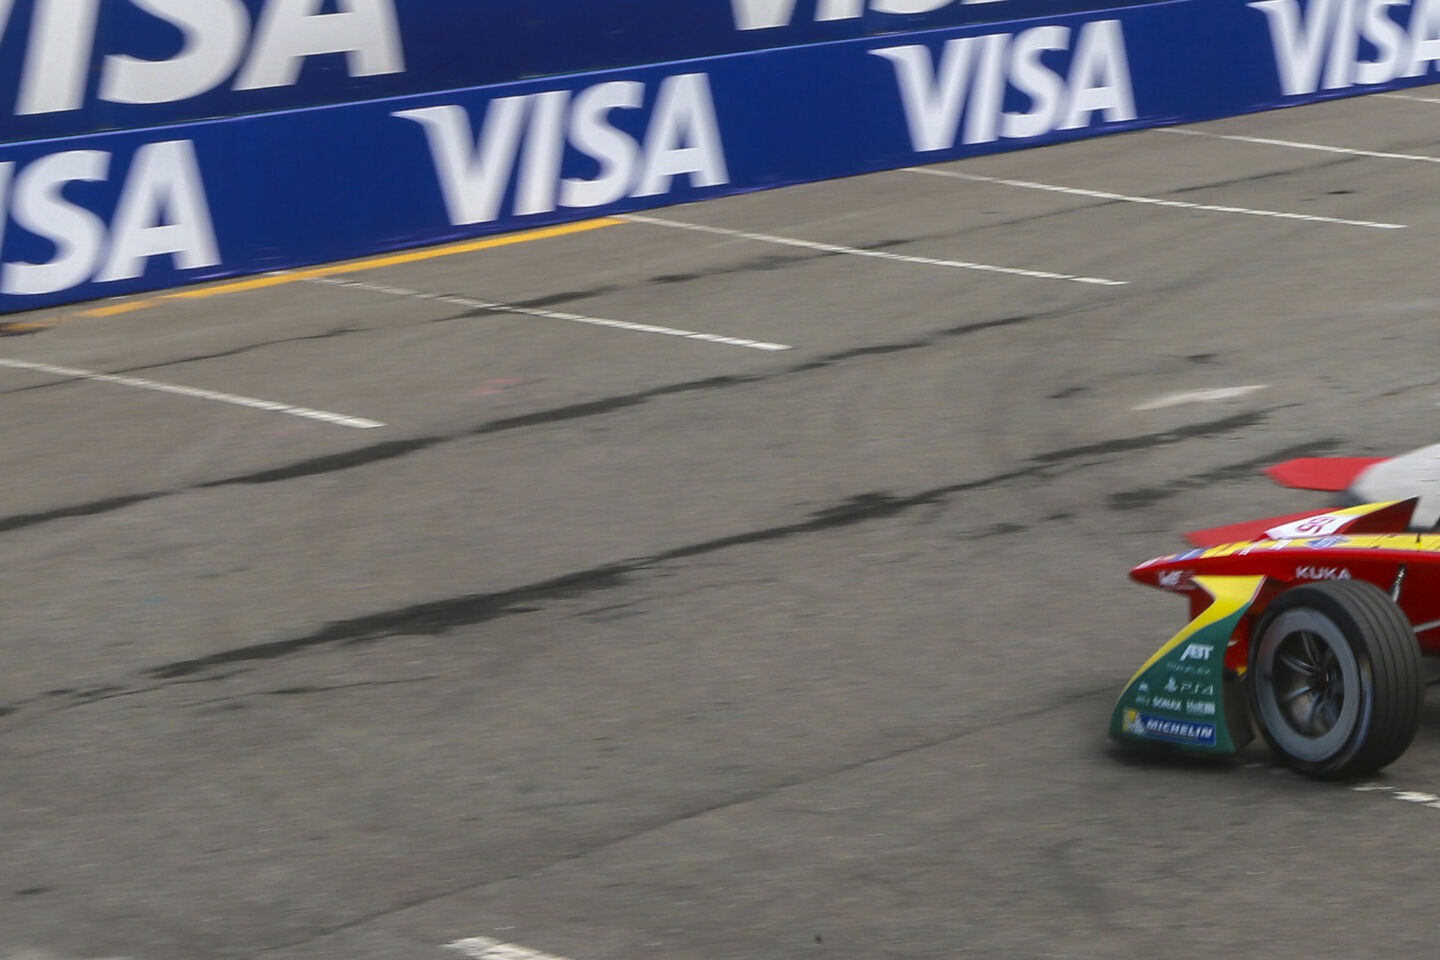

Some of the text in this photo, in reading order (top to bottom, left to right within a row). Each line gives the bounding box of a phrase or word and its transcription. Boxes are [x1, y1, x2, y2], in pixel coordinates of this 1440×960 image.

[867, 20, 1137, 153] VISA
[389, 72, 730, 226] VISA
[1296, 566, 1351, 580] KUKA
[1179, 643, 1214, 661] ABT
[1146, 718, 1213, 739] MICHELIN
